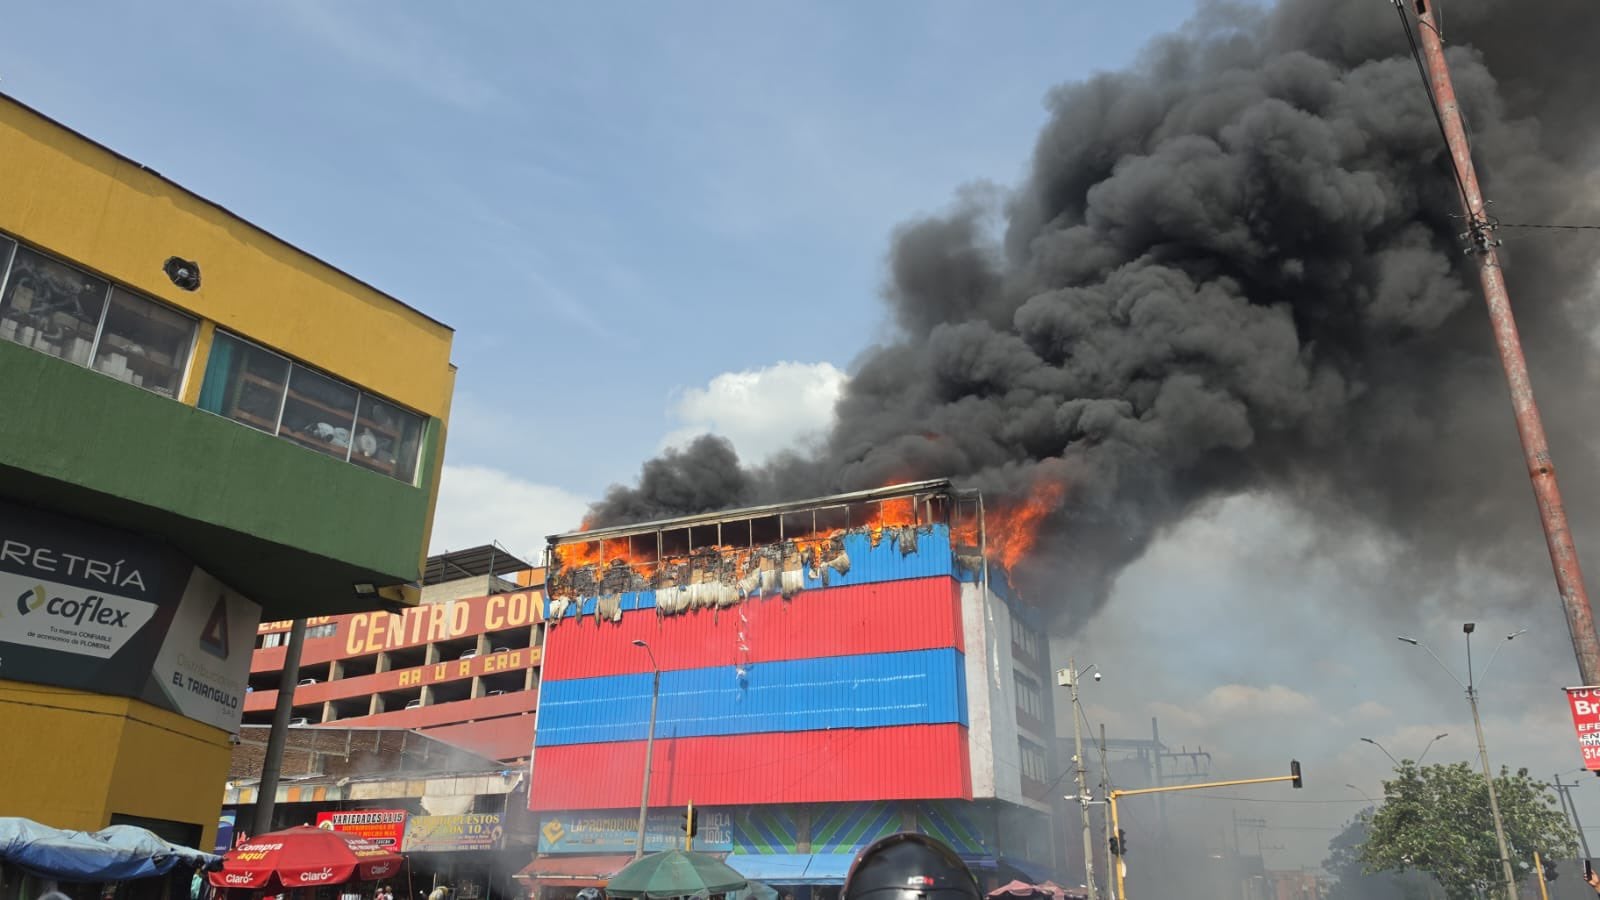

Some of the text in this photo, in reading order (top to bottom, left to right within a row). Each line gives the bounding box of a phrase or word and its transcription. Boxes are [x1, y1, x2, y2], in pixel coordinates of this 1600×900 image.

[0, 540, 147, 592] RETRÍA
[47, 596, 130, 628] coflex
[346, 602, 470, 655] CENTRO
[172, 671, 238, 709] EL TRIANGULO
[333, 814, 382, 825] VARIEDADES
[237, 842, 284, 853] Compra
[236, 850, 269, 862] aquí
[226, 872, 252, 884] Claro
[300, 869, 331, 882] Claro
